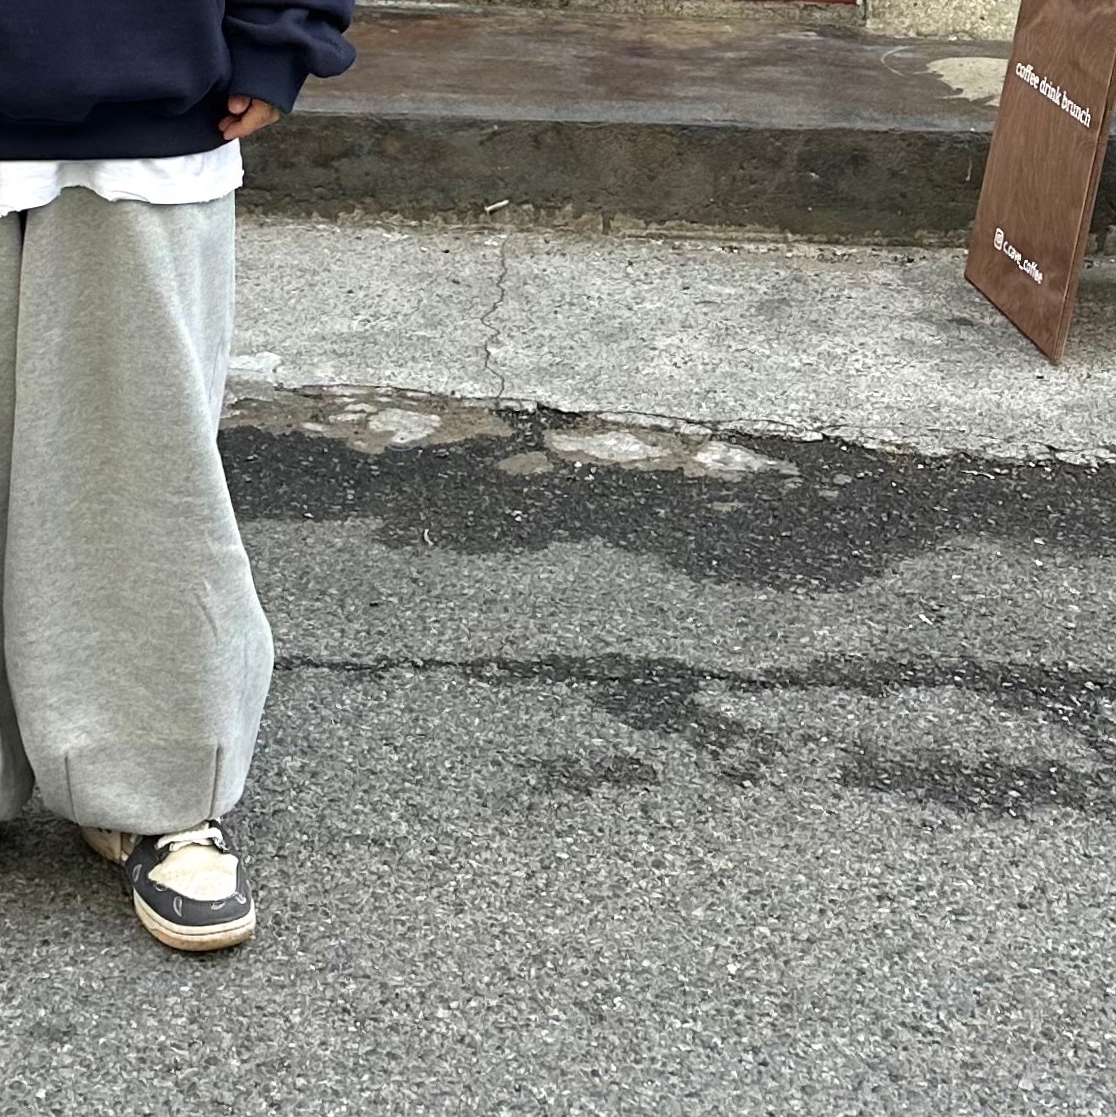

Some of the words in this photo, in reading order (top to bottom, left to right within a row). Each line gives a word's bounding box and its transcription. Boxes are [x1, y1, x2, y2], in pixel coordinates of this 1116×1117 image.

[1015, 62, 1040, 90] coffee
[1039, 76, 1062, 106] drink
[1061, 90, 1092, 129] brunch
